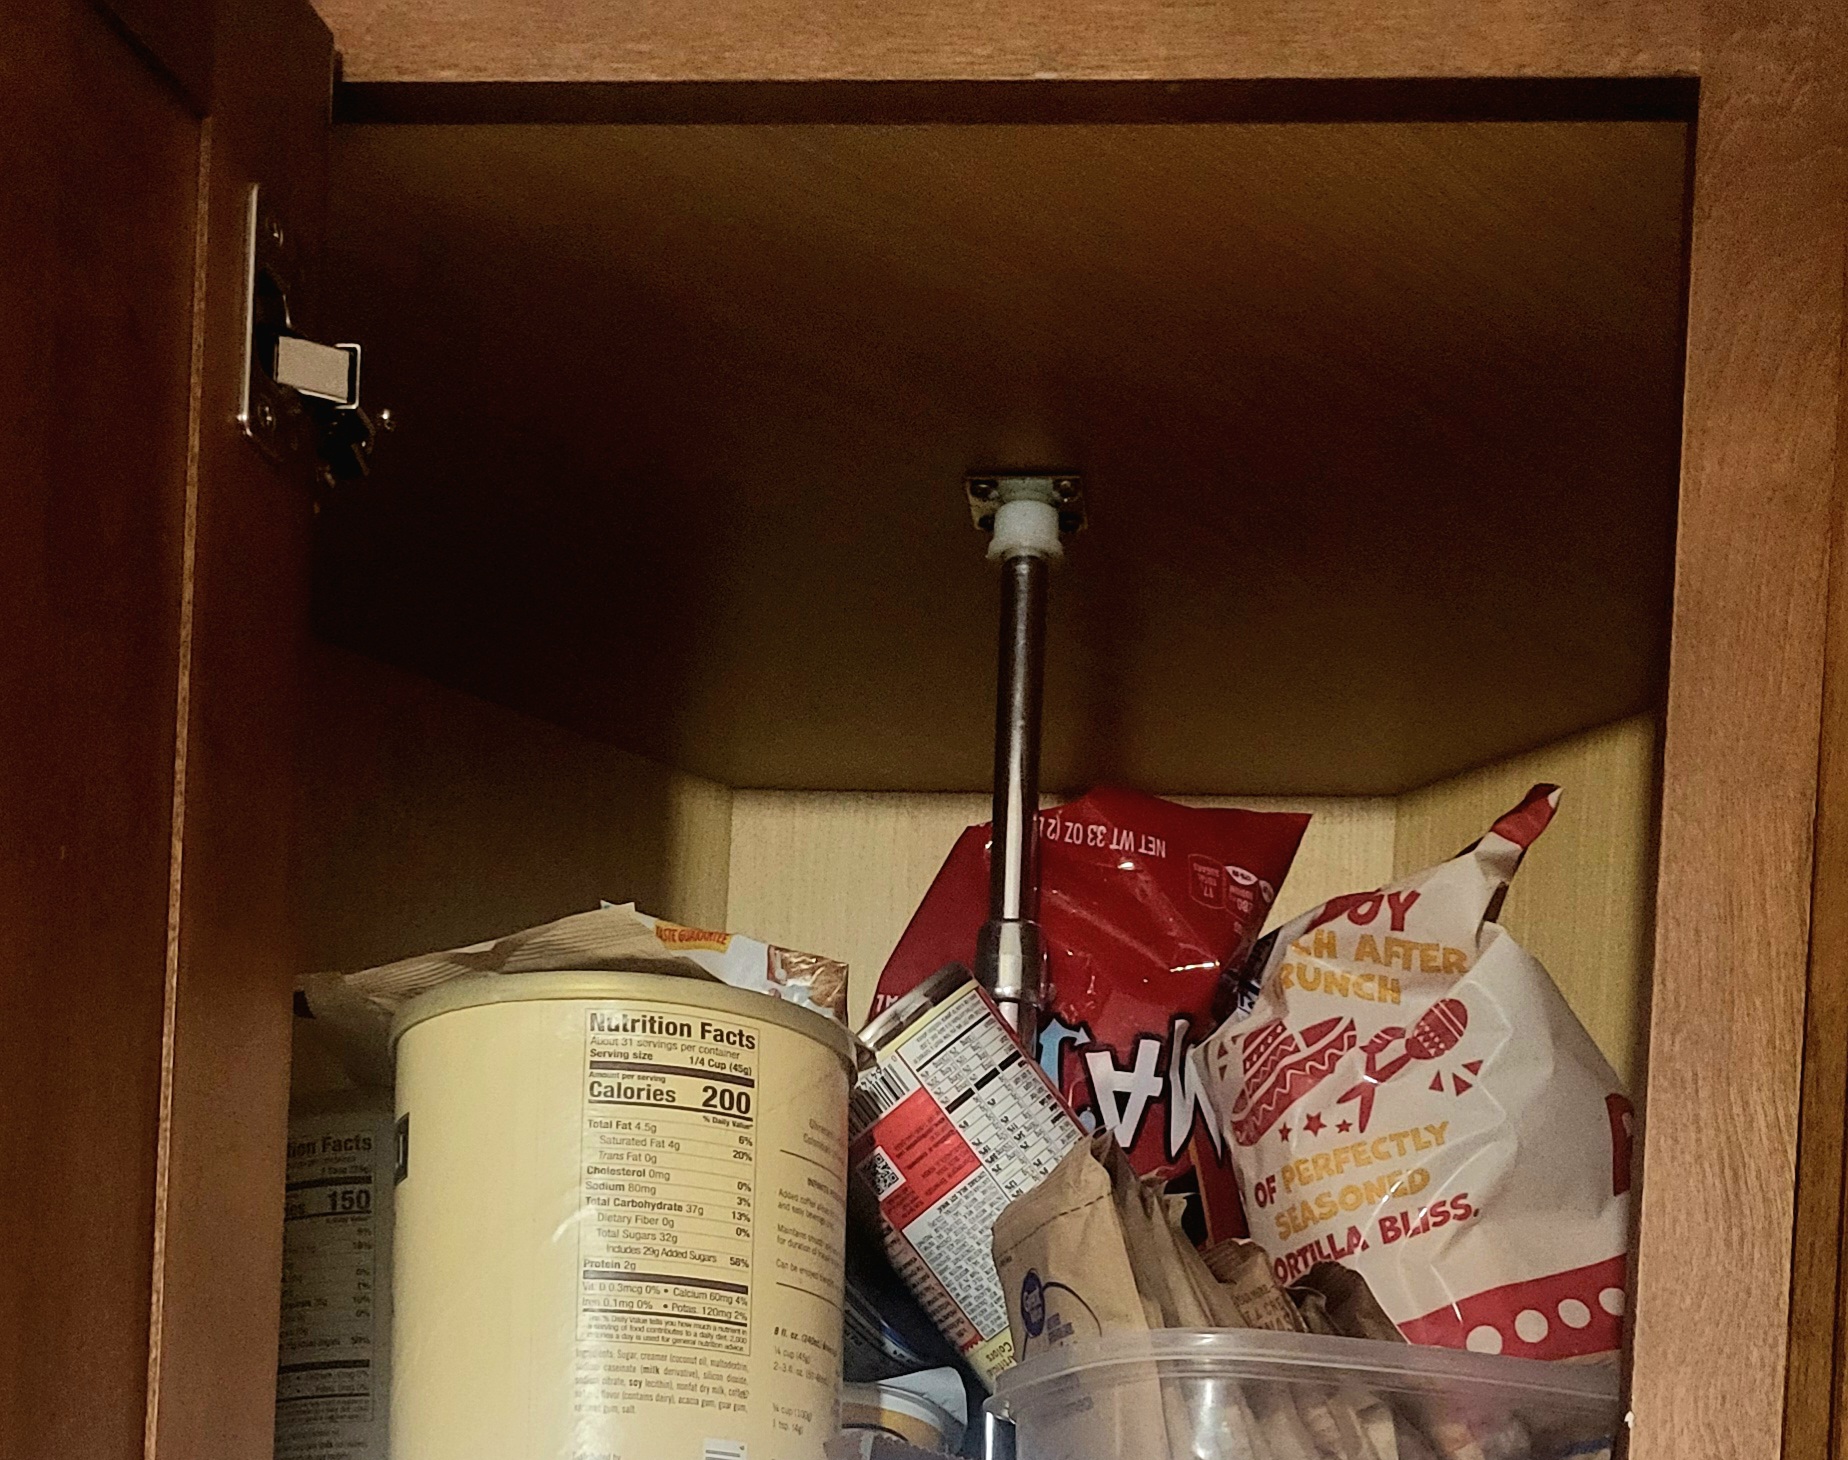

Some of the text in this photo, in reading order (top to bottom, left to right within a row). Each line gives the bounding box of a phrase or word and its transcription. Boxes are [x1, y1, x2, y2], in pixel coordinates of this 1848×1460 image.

[1065, 821, 1082, 845] OZ
[1087, 826, 1106, 847] 33
[1110, 828, 1134, 852] WT
[1139, 837, 1166, 858] NET
[1354, 933, 1470, 975] AFTER
[1280, 962, 1401, 1005] RUNCH
[590, 1012, 756, 1050] Nutrition Facts
[621, 1038, 633, 1047] 31
[637, 1039, 678, 1051] servings
[681, 1044, 696, 1054] per
[698, 1046, 740, 1060] container
[590, 1049, 753, 1077] Serving size 1/4 Cup (45g)
[621, 1073, 666, 1083] per serving
[589, 1081, 751, 1115] Calories 200
[588, 1119, 657, 1134] Total Fat 4.5g
[712, 1117, 730, 1128] Daily
[322, 1134, 372, 1152] Facts
[599, 1135, 681, 1151] Saturated Fat 4g
[738, 1136, 753, 1147] 6%
[599, 1151, 657, 1164] Trans Fat 0g
[732, 1150, 753, 1162] 20%
[1281, 1121, 1449, 1193] PERFECTLY
[586, 1165, 670, 1181] Cholesterol 0mg
[585, 1181, 657, 1196] Sodium 80mg
[736, 1181, 752, 1192] 0%
[1254, 1175, 1277, 1208] OF
[327, 1190, 371, 1211] 150
[585, 1196, 704, 1216] Total Carbohydrate 37g
[736, 1196, 751, 1207] 3%
[1274, 1167, 1431, 1240] SEASONED
[597, 1213, 750, 1238] Dietary Fiber 0g 0%
[732, 1211, 751, 1223] 13%
[597, 1228, 678, 1244] Total Sugars 32g
[1273, 1192, 1480, 1286] ORTILLA BLISS.
[583, 1259, 637, 1271] Protein 2g
[606, 1244, 749, 1268] Includes 29g Added Sugars 58%
[608, 1283, 748, 1306] 0.3mcg 0% Calcium 60mg 4%
[603, 1298, 748, 1321] 0.1mg 0% 120mg 2%
[986, 1341, 1012, 1363] Colors
[629, 1379, 643, 1389] soy
